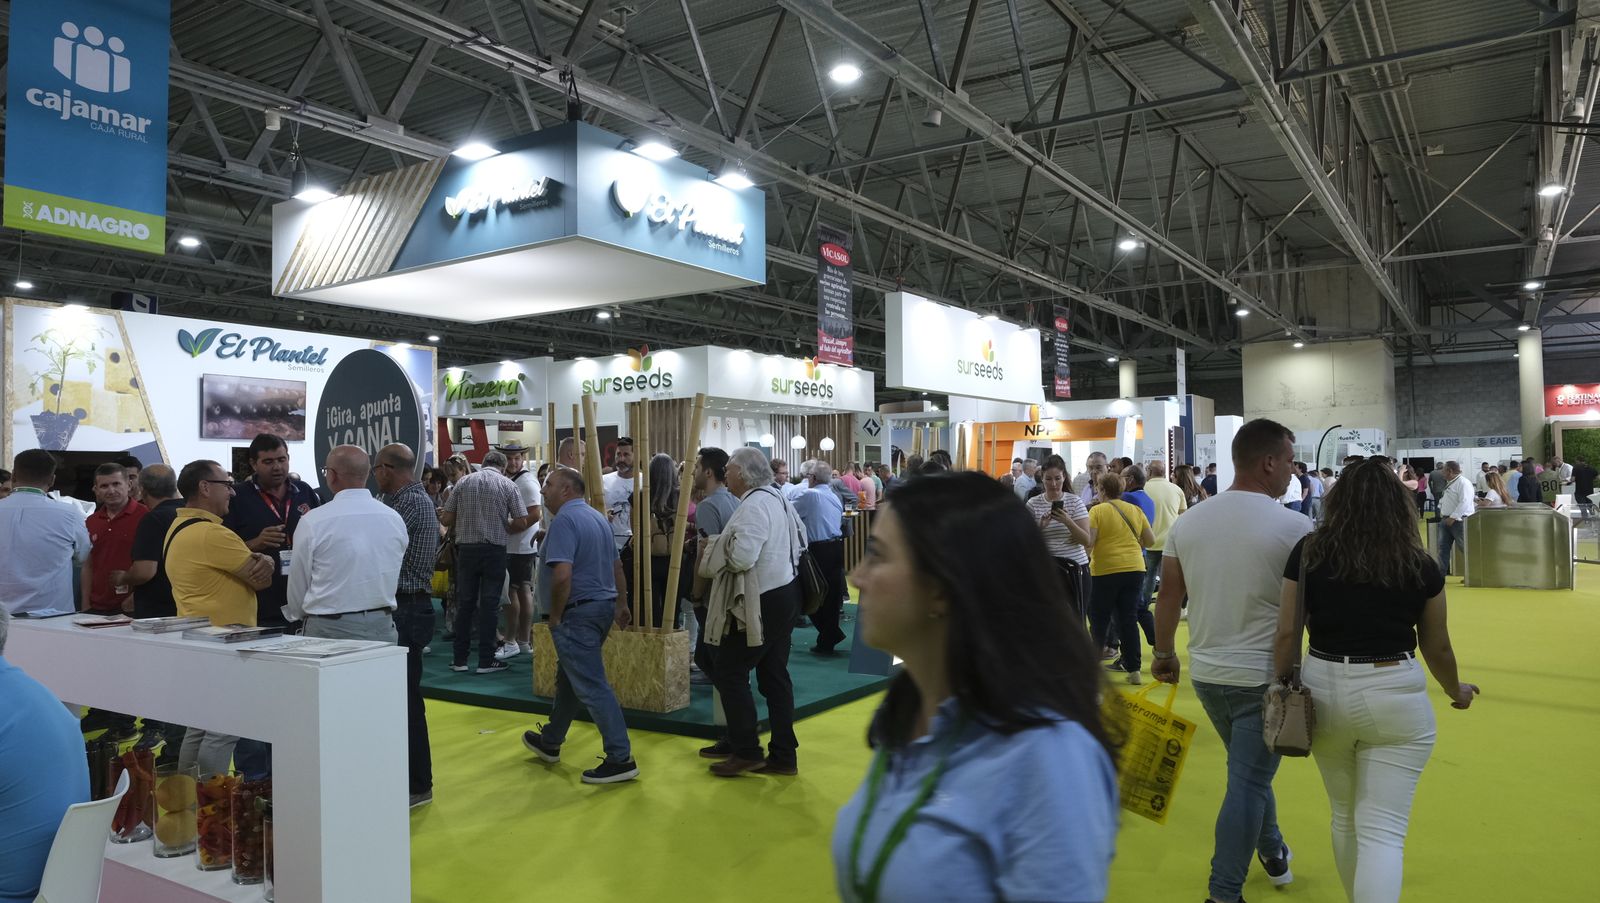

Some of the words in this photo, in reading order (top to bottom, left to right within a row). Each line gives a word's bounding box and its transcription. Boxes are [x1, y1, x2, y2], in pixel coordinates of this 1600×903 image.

[26, 88, 152, 134] cajamar
[90, 121, 115, 135] CAJA
[118, 128, 148, 144] RURAL
[36, 204, 150, 240] ADNAGRO
[708, 239, 740, 256] Semilleros
[822, 247, 849, 264] VICASOL
[216, 333, 248, 359] El
[249, 336, 329, 365] Plantel
[288, 364, 325, 373] Semilleros
[957, 359, 1004, 381] surseeds
[443, 370, 520, 403] Hazera
[581, 366, 673, 395] surseeds
[771, 377, 834, 399] surseeds
[326, 406, 356, 430] ¡Gira,
[360, 393, 401, 424] apunta
[1434, 438, 1460, 447] EARIS
[1490, 436, 1518, 445] EARIS
